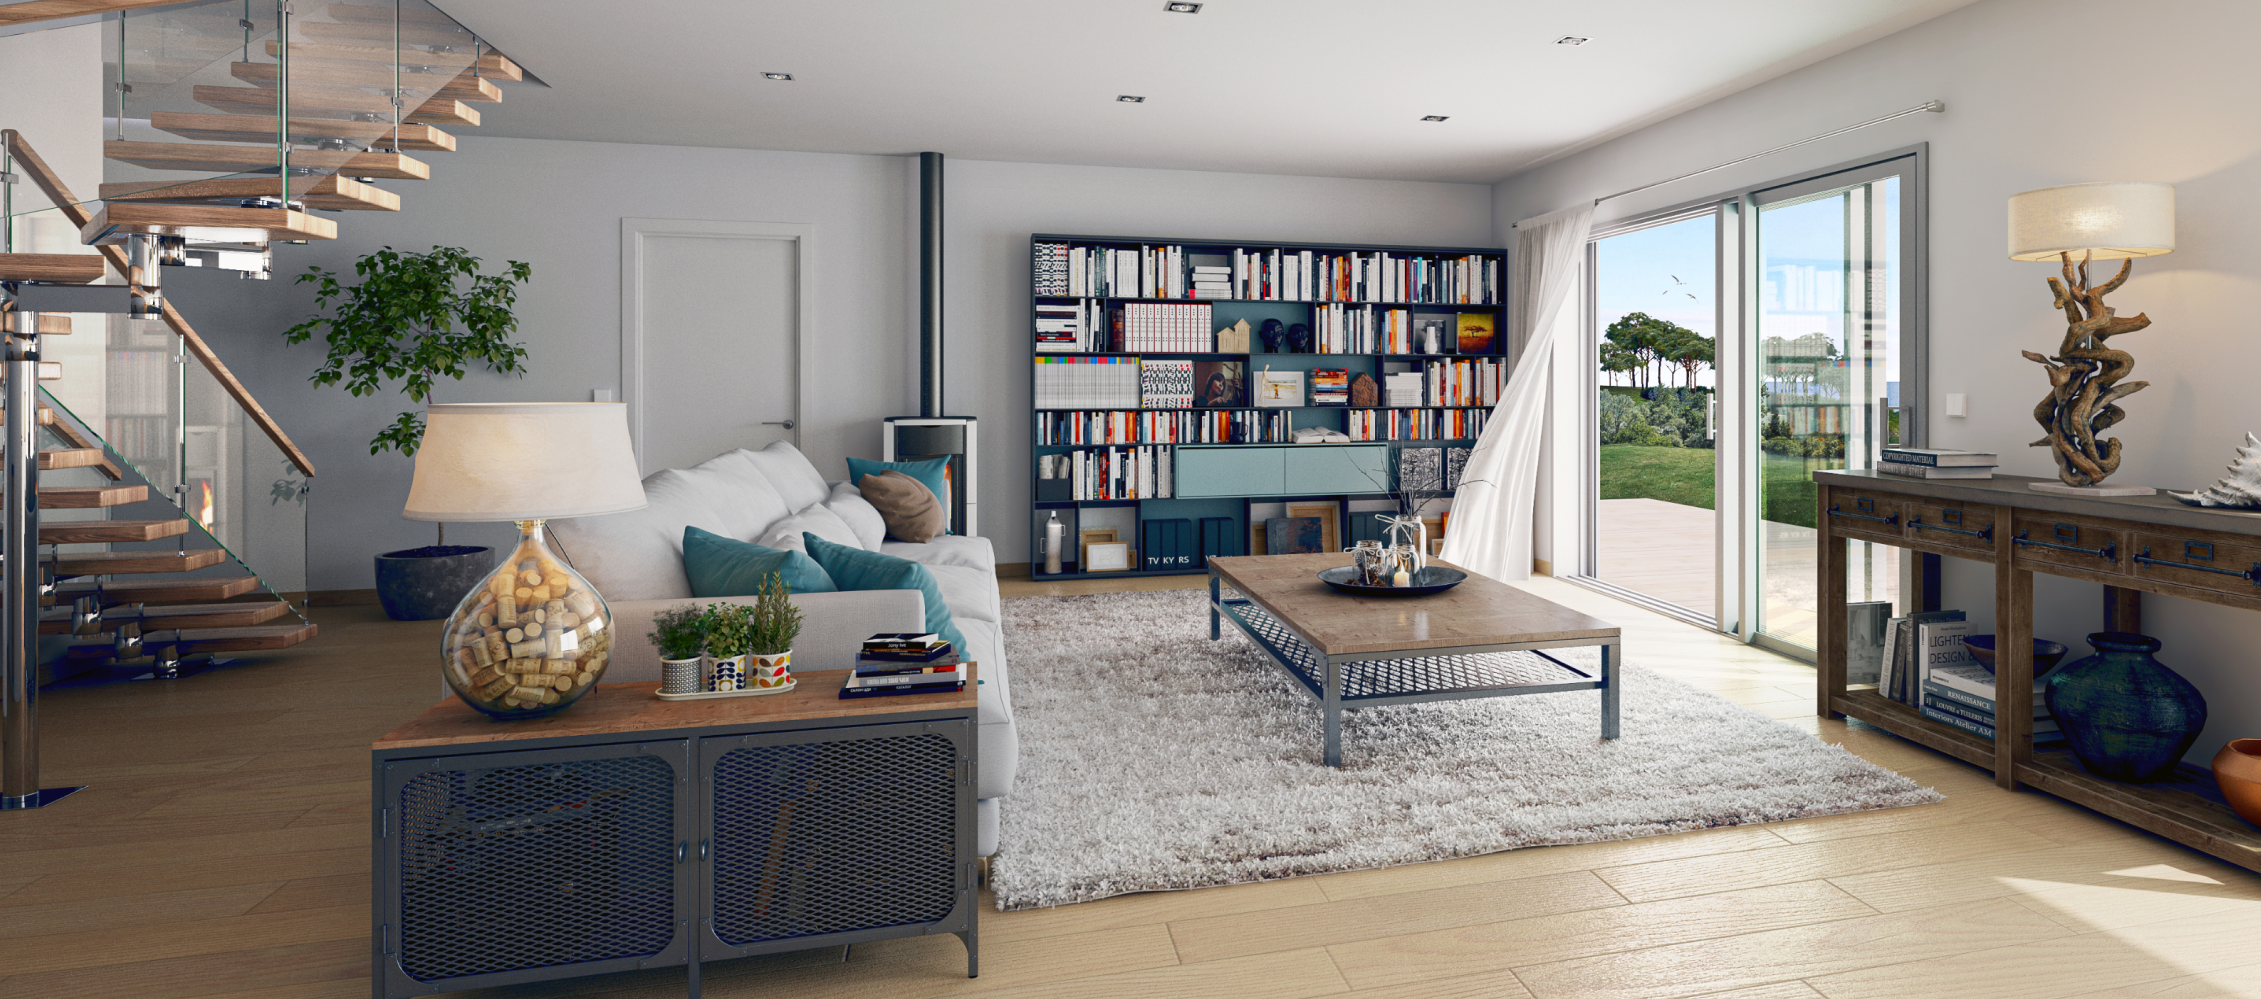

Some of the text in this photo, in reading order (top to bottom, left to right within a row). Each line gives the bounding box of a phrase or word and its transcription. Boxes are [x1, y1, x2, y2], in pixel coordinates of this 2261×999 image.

[1882, 452, 1934, 465] COPYRIGHTED MATERIAL
[1878, 462, 1923, 477] ELEMENTS OF STYLE
[1147, 557, 1159, 565] TV
[1162, 556, 1175, 564] KY
[1178, 555, 1190, 564] RS
[1887, 623, 1895, 646] VANITY
[1930, 651, 1965, 664] DESIGN
[1881, 674, 1889, 694] YEARS
[1947, 690, 1991, 710] RENAISSANCE
[1936, 701, 1956, 713] LOUVRE
[1926, 708, 1954, 724] Interiors
[1954, 719, 1977, 732] Atelier
[1978, 727, 1992, 738] AM
